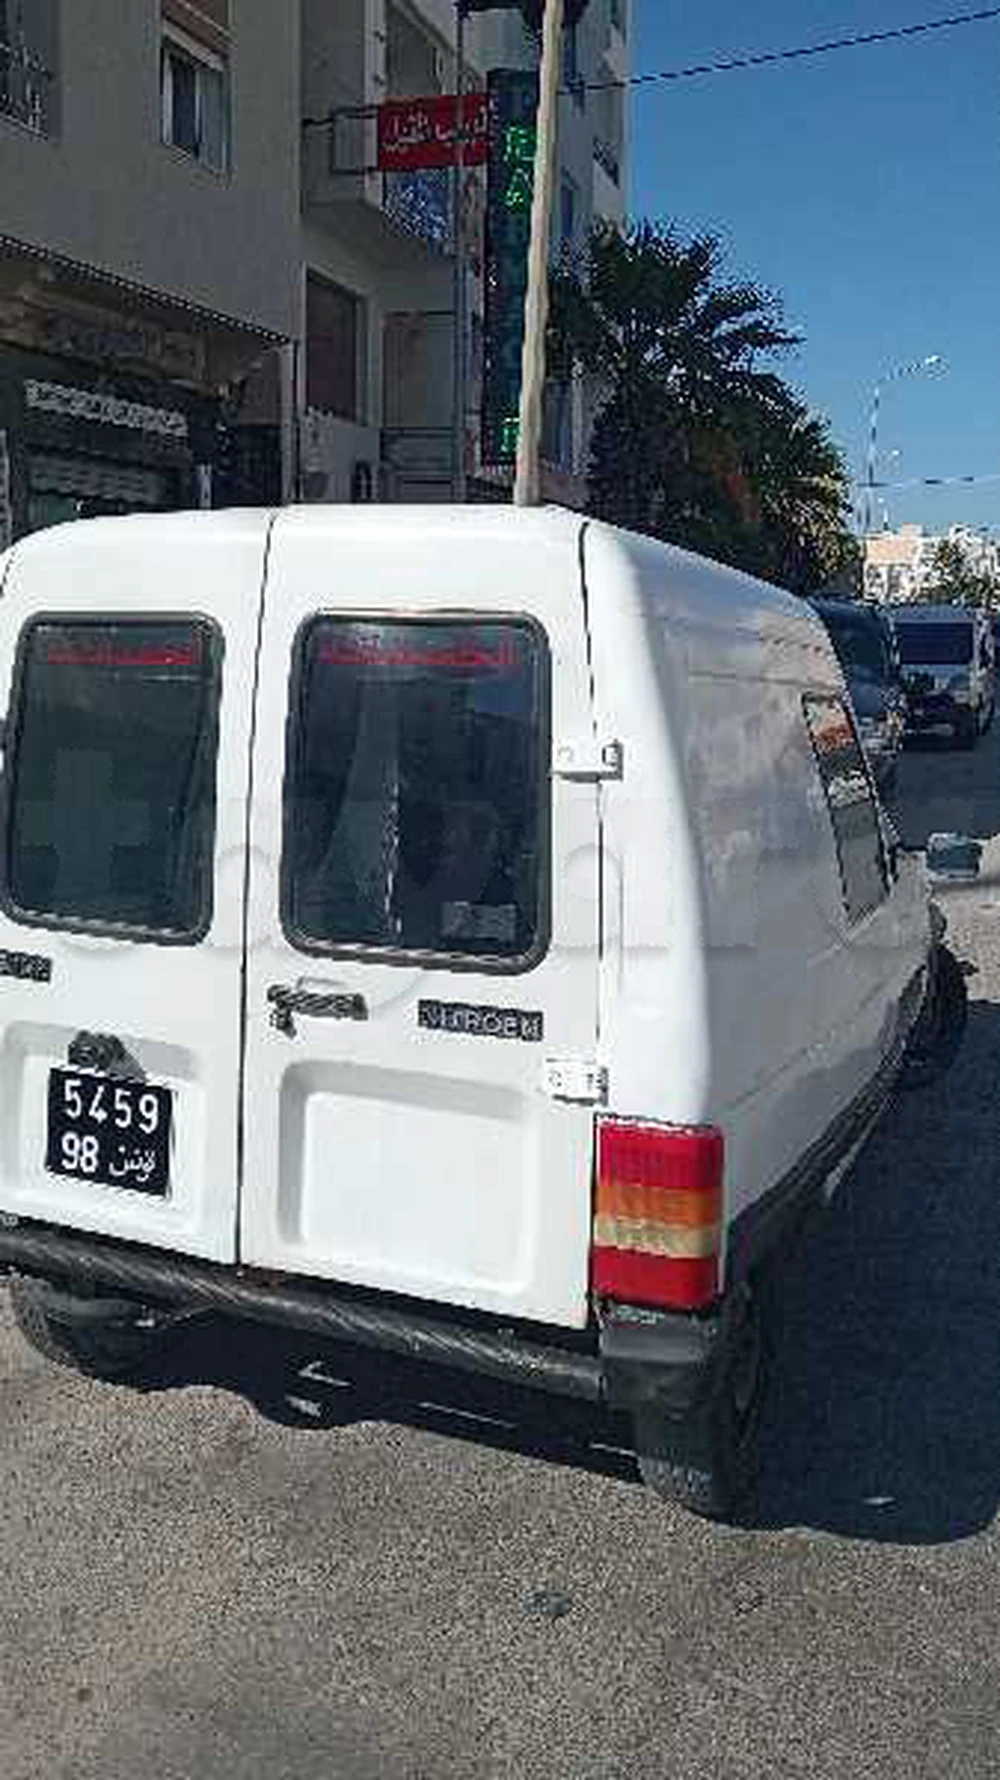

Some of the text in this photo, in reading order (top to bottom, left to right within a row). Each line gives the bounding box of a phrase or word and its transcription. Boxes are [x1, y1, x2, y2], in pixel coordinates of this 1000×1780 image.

[63, 1078, 160, 1134] 5459
[60, 1131, 156, 1182] 98 تونس
